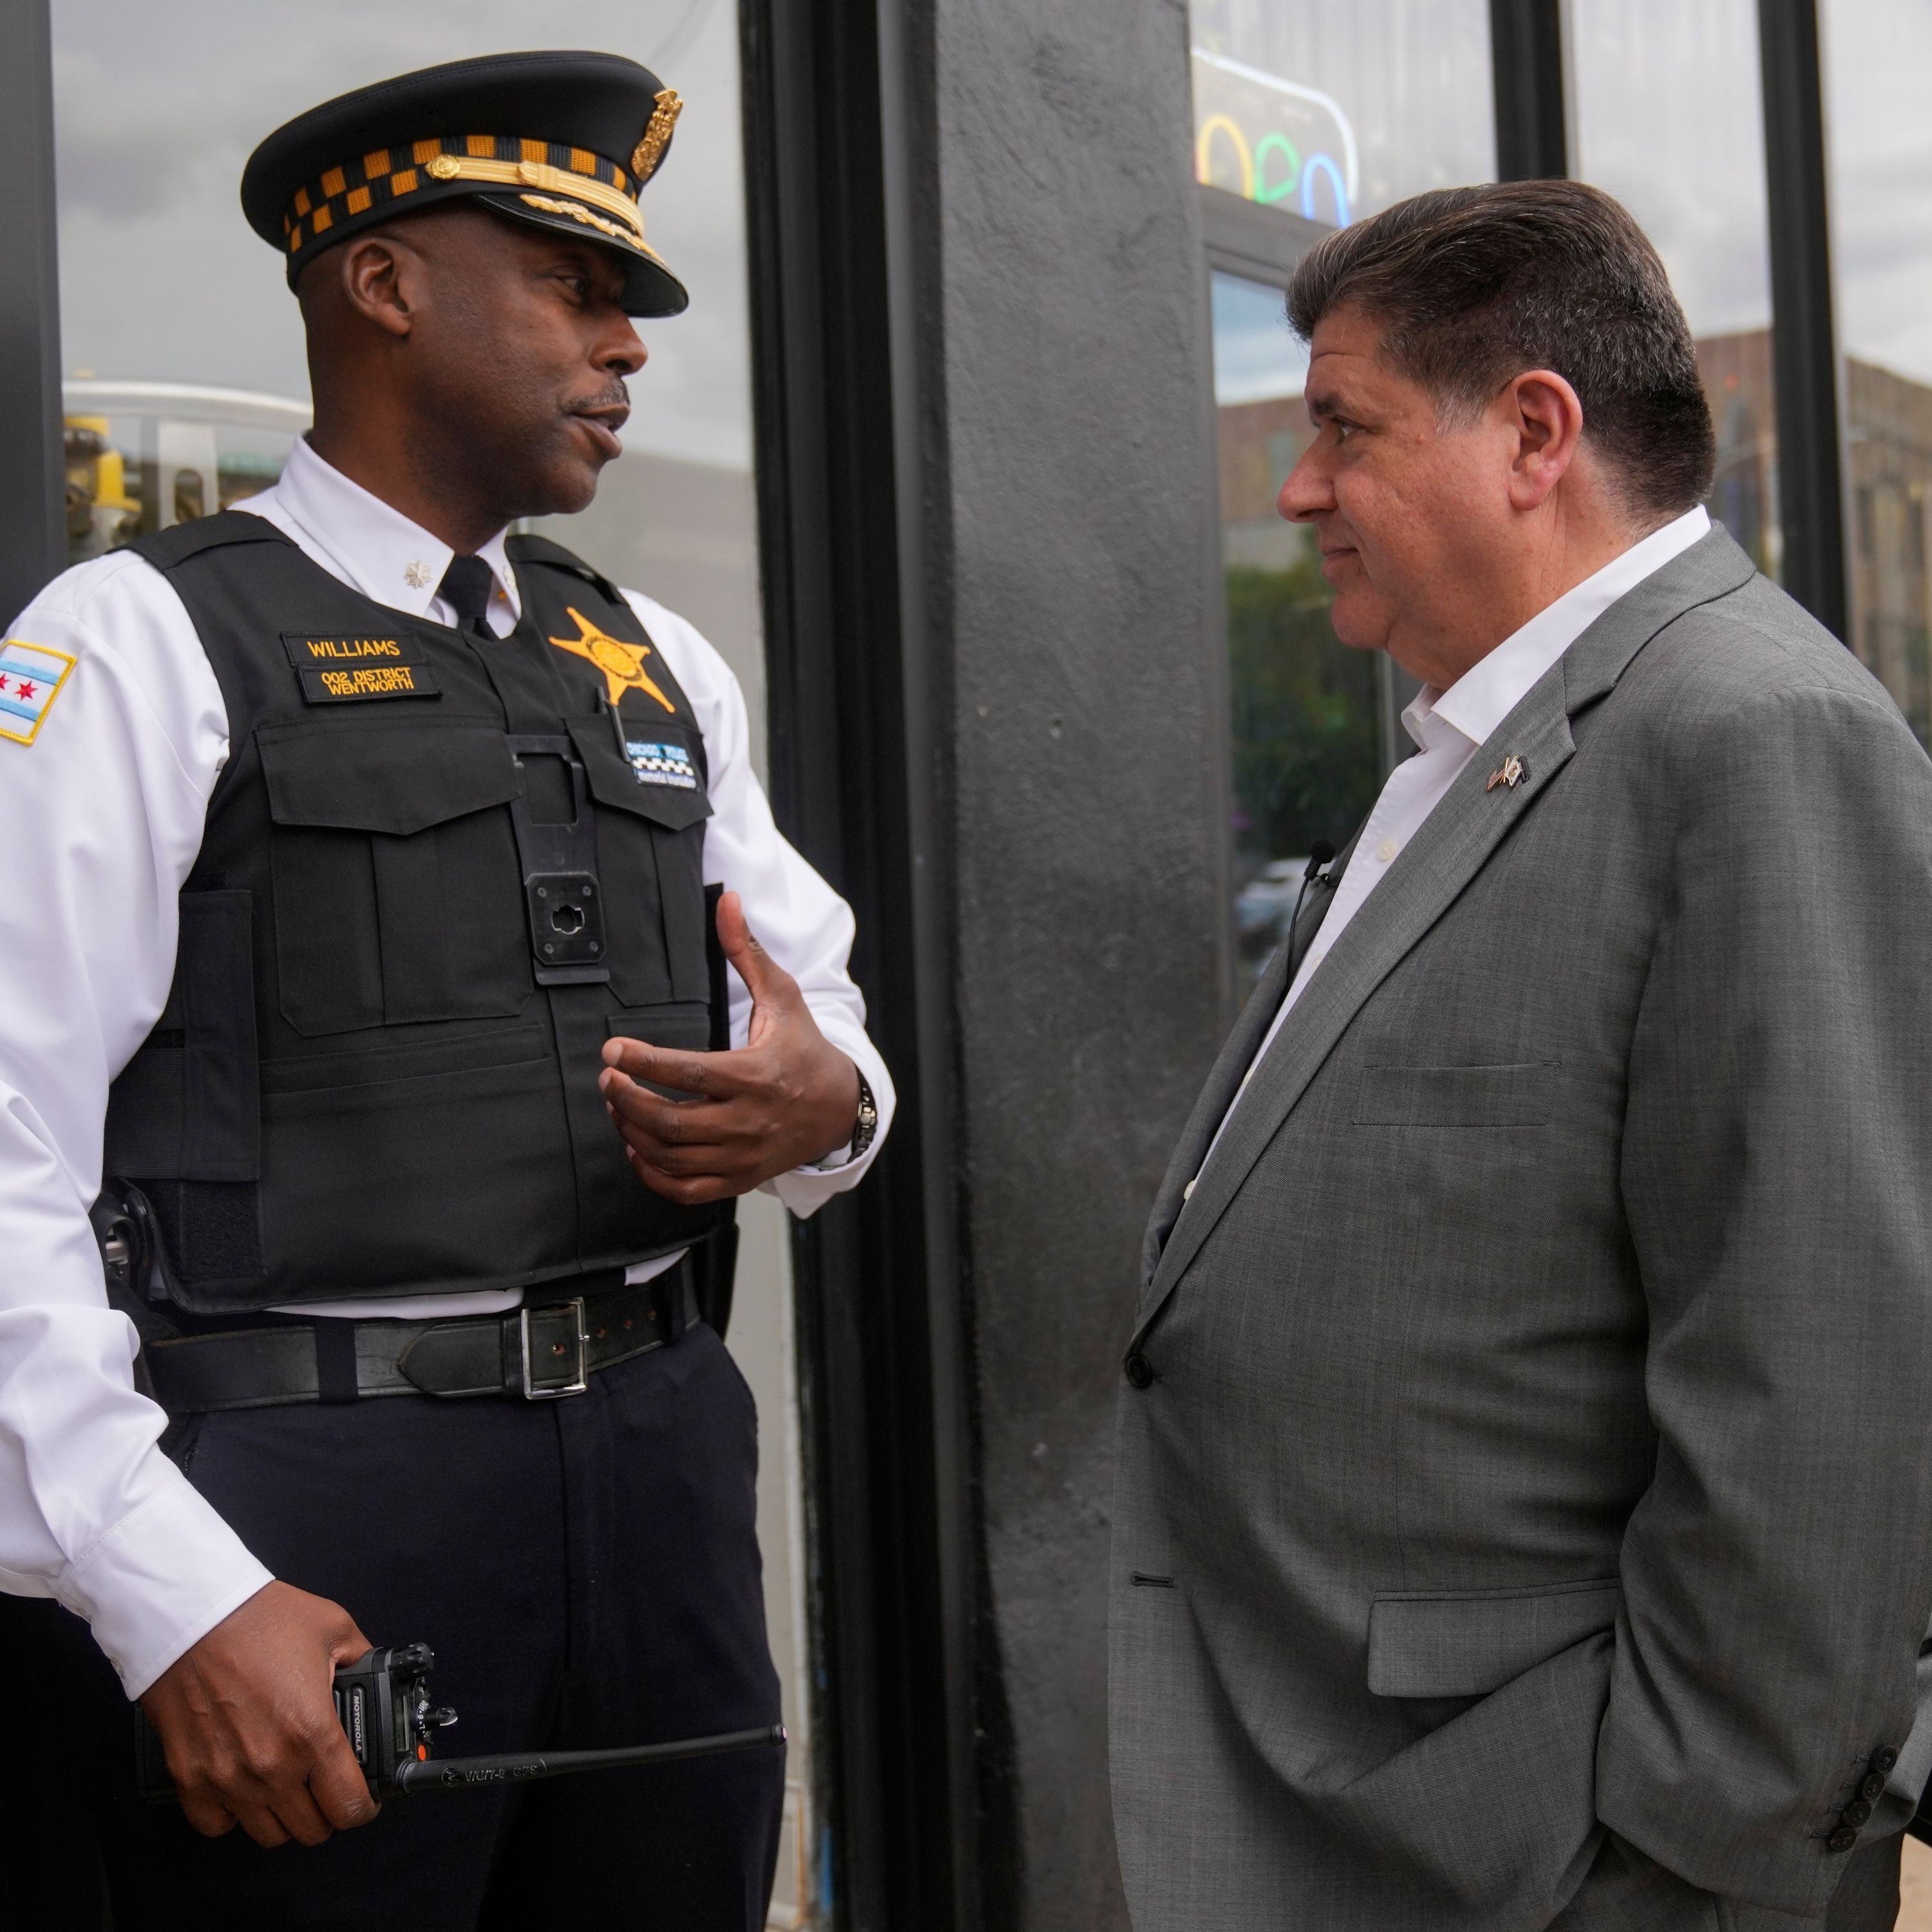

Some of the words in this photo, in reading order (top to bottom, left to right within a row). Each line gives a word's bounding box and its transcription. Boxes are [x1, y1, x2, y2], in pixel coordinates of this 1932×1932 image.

[307, 640, 401, 658] WILLIAMS
[322, 671, 350, 685] 002
[353, 667, 411, 683] DISTRICT
[328, 677, 415, 696] WENTWORTH
[353, 1696, 363, 1752] MOTOROLA
